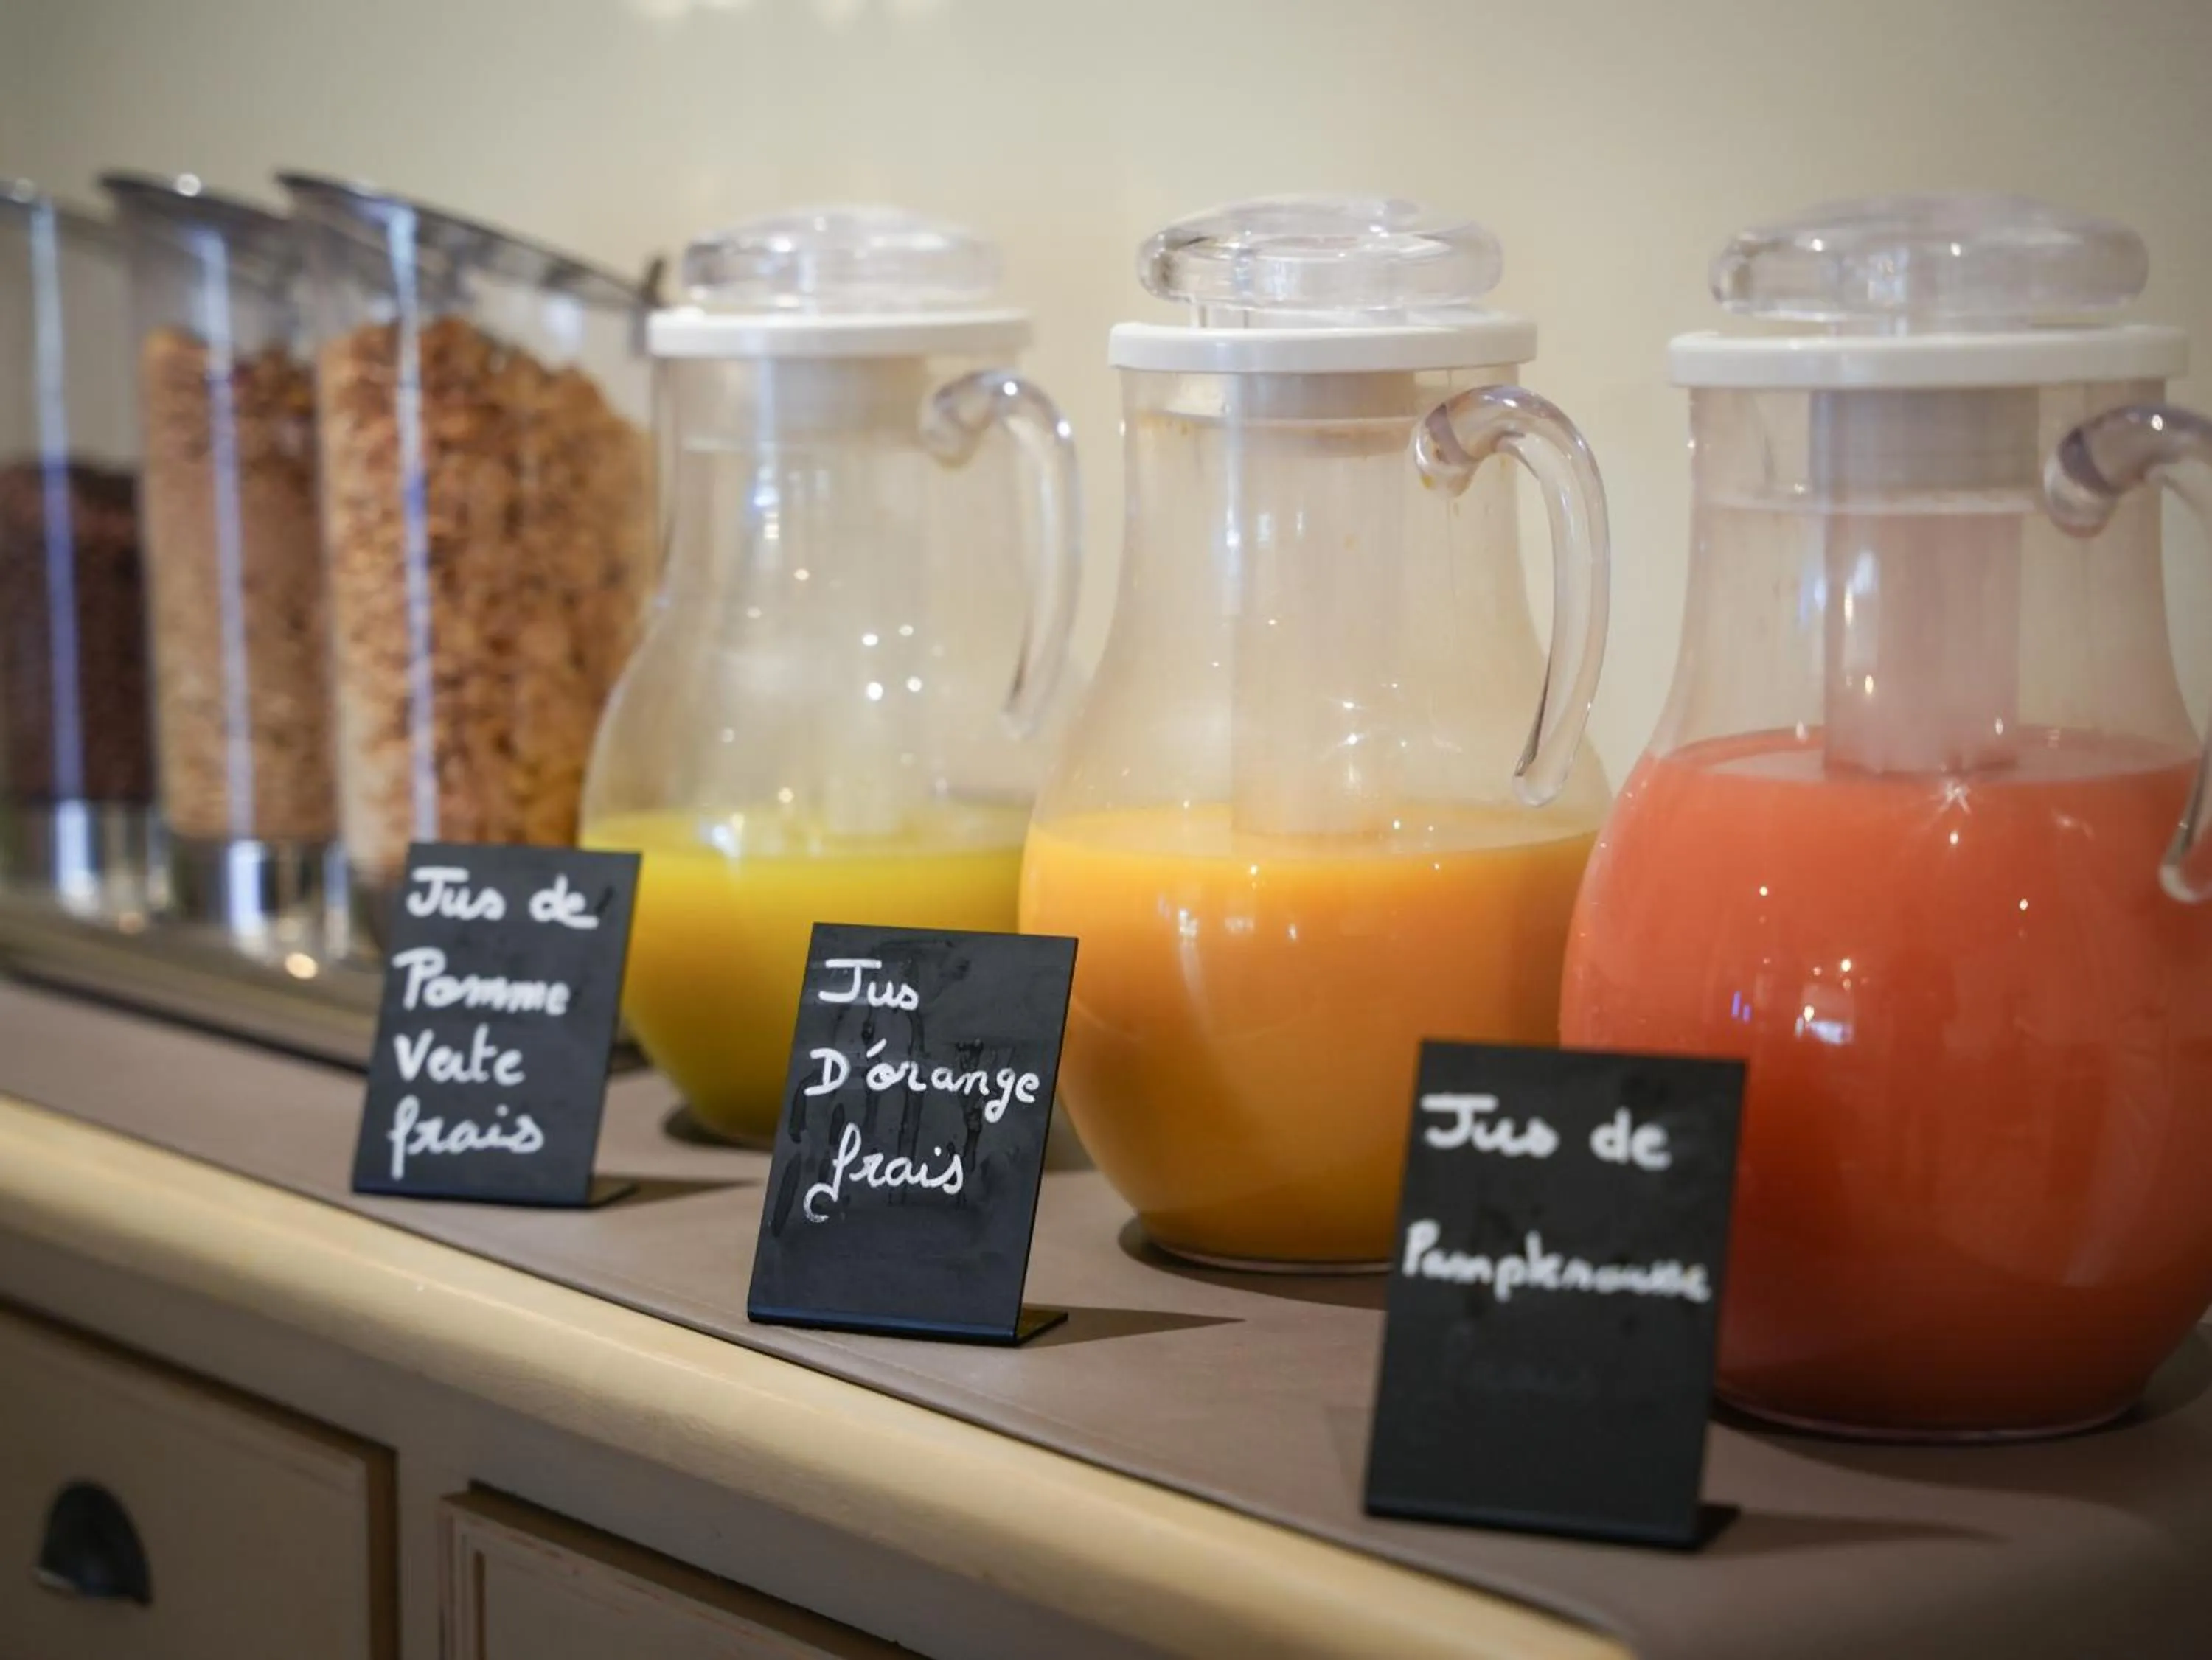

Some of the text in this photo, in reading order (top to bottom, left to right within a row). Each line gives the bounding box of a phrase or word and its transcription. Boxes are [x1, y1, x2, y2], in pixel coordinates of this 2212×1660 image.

[406, 866, 599, 929] Jus de
[392, 946, 571, 1016] Pomme
[818, 958, 919, 1010] Jus
[388, 1095, 544, 1179] frais
[1421, 1094, 1672, 1171] Jus de
[803, 1123, 964, 1222] frais
